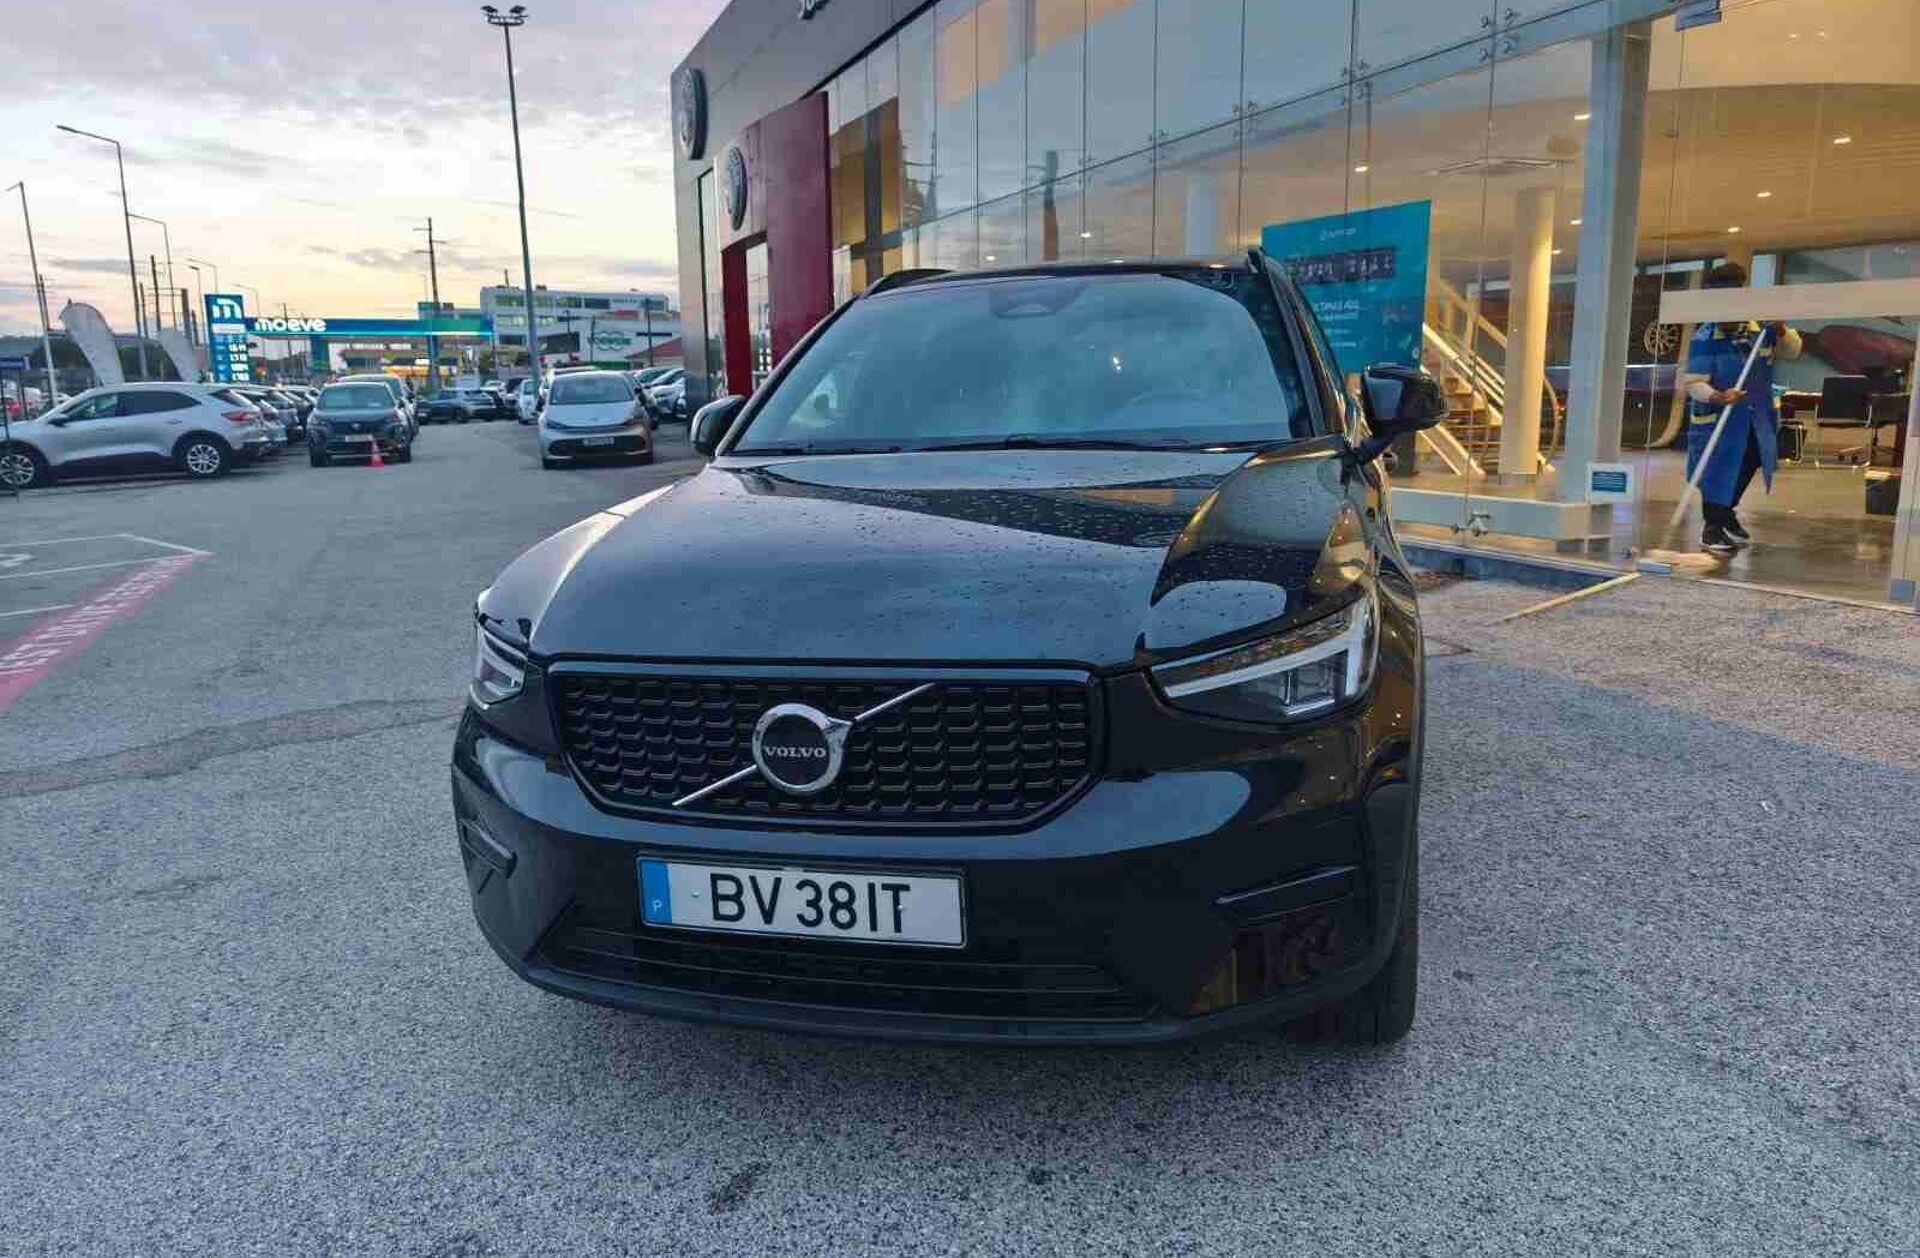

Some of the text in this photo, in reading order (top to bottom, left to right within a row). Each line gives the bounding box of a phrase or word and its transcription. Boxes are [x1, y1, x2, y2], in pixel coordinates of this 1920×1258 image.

[254, 318, 327, 332] moeve
[763, 746, 827, 758] VOLVO
[653, 900, 663, 913] P
